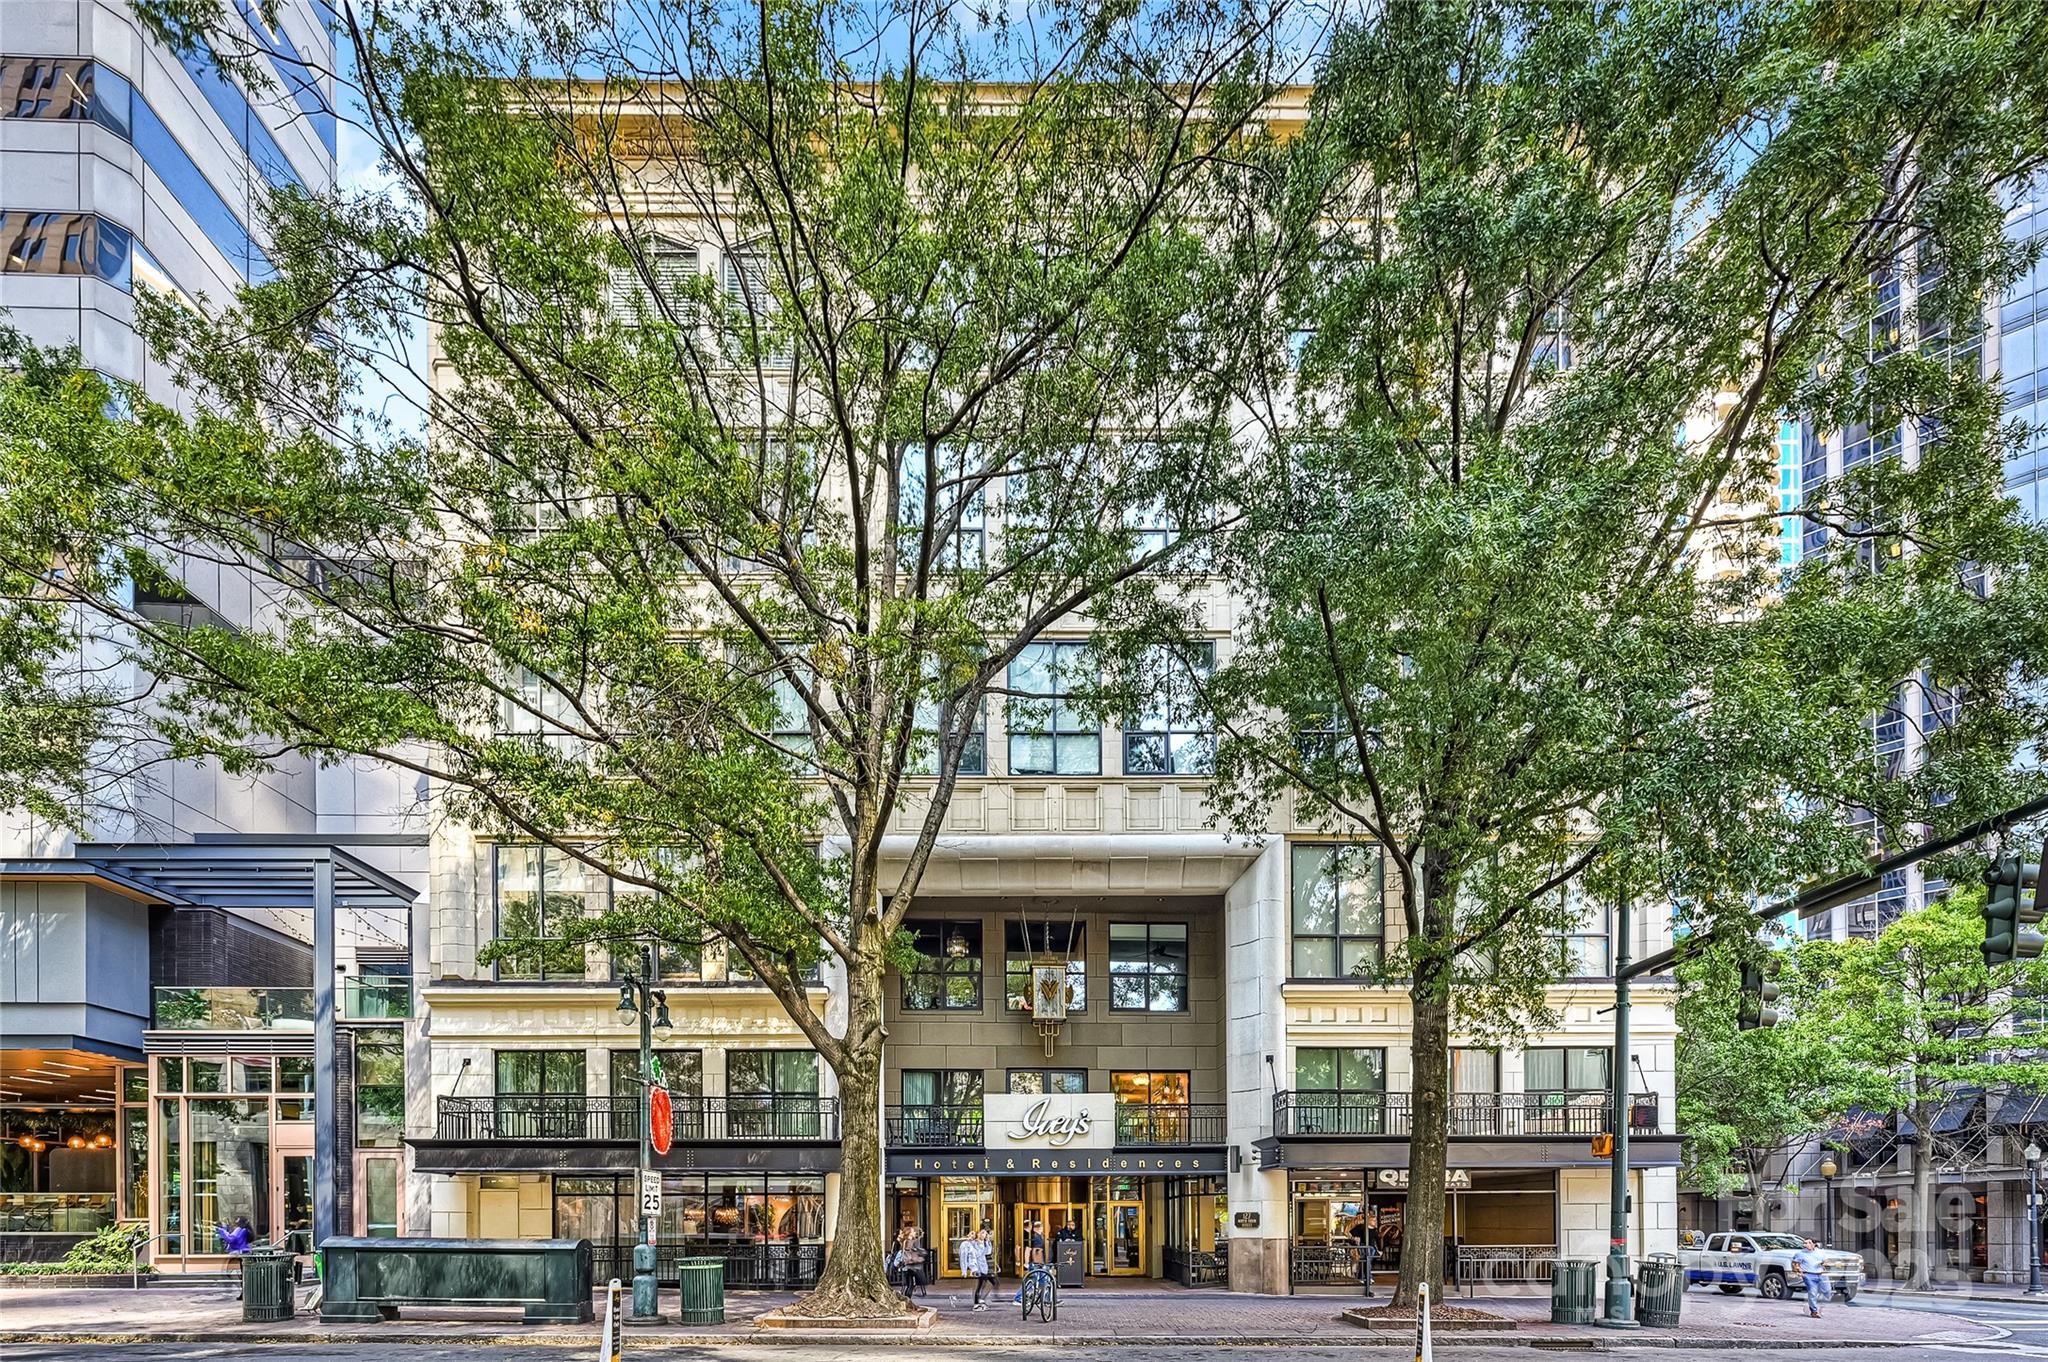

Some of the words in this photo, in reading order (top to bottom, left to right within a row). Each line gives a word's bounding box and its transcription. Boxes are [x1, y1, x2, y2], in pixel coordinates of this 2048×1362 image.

[1008, 1096, 1091, 1146] Ivey's
[914, 1158, 990, 1169] Hotel
[1006, 1158, 1015, 1169] &
[1032, 1158, 1200, 1169] Residences
[644, 1174, 660, 1184] SPEED
[1379, 1169, 1469, 1186] QDA
[644, 1194, 660, 1210] 25
